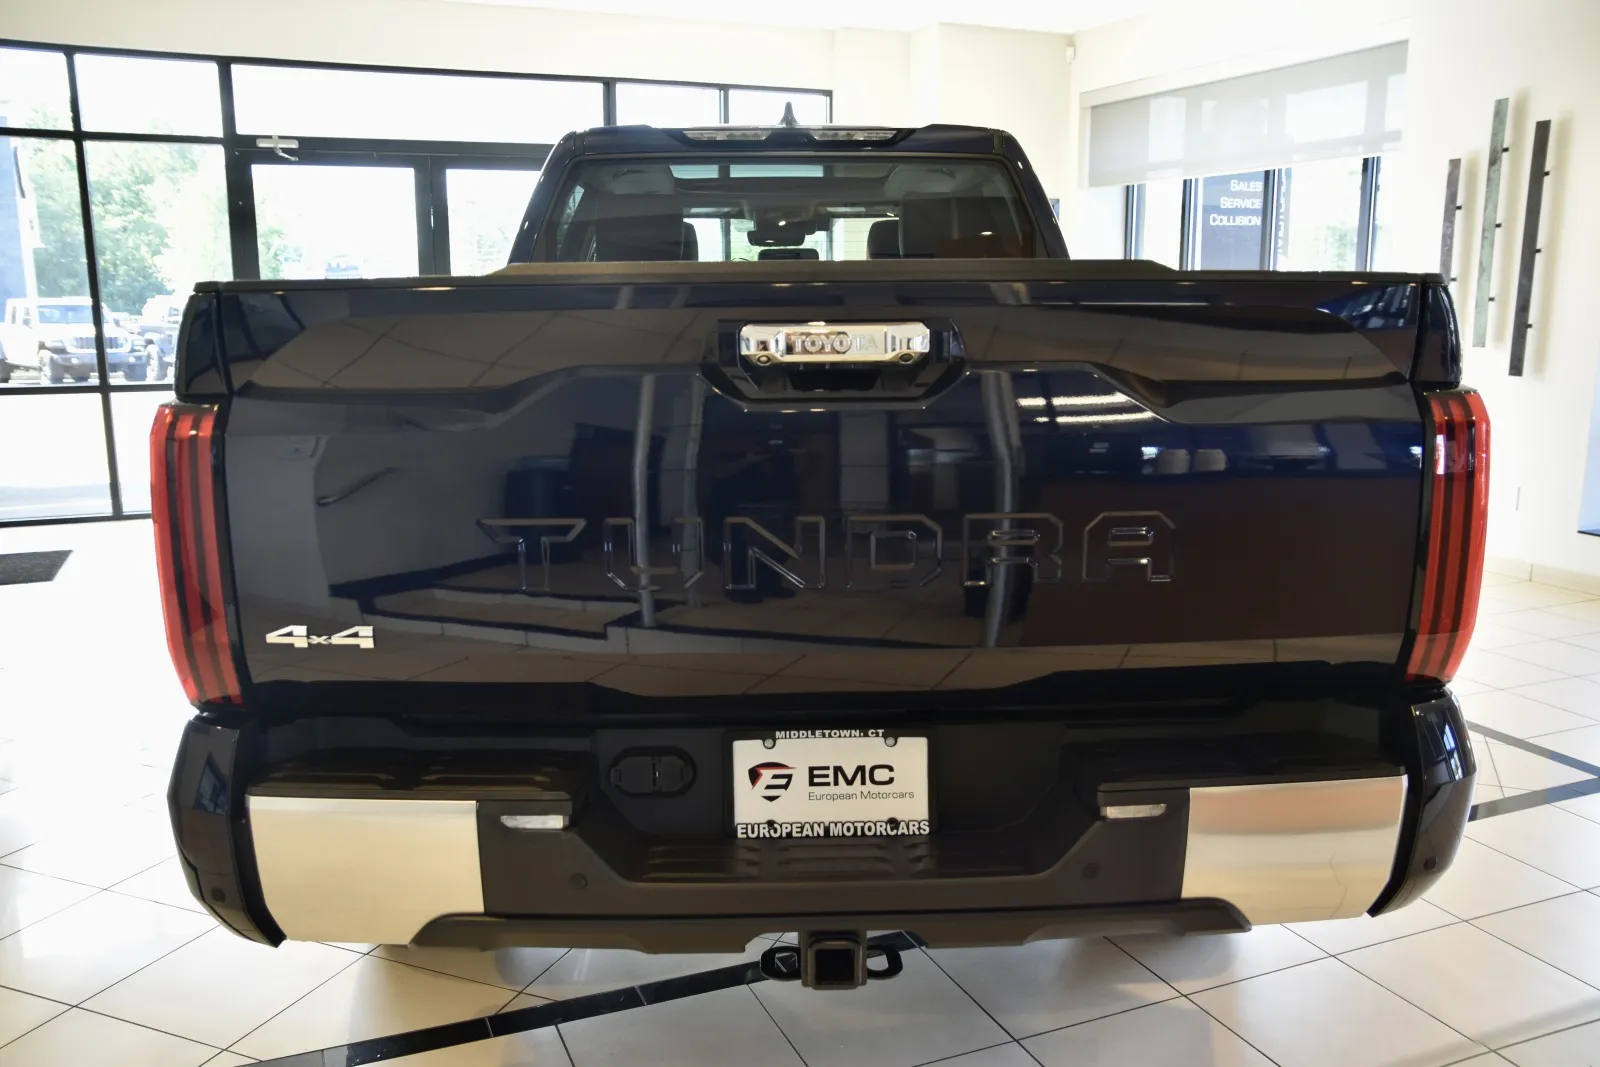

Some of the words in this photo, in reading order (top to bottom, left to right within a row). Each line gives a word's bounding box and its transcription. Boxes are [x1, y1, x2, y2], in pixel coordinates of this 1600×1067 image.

[791, 333, 879, 353] TOYOTA
[477, 510, 1176, 592] TUNDRA
[868, 729, 885, 737] CT
[808, 764, 895, 787] EMC
[808, 791, 857, 802] European
[860, 790, 915, 800] Motorcars
[737, 821, 825, 838] EUROPEAN
[829, 820, 930, 837] MOTORCARS
